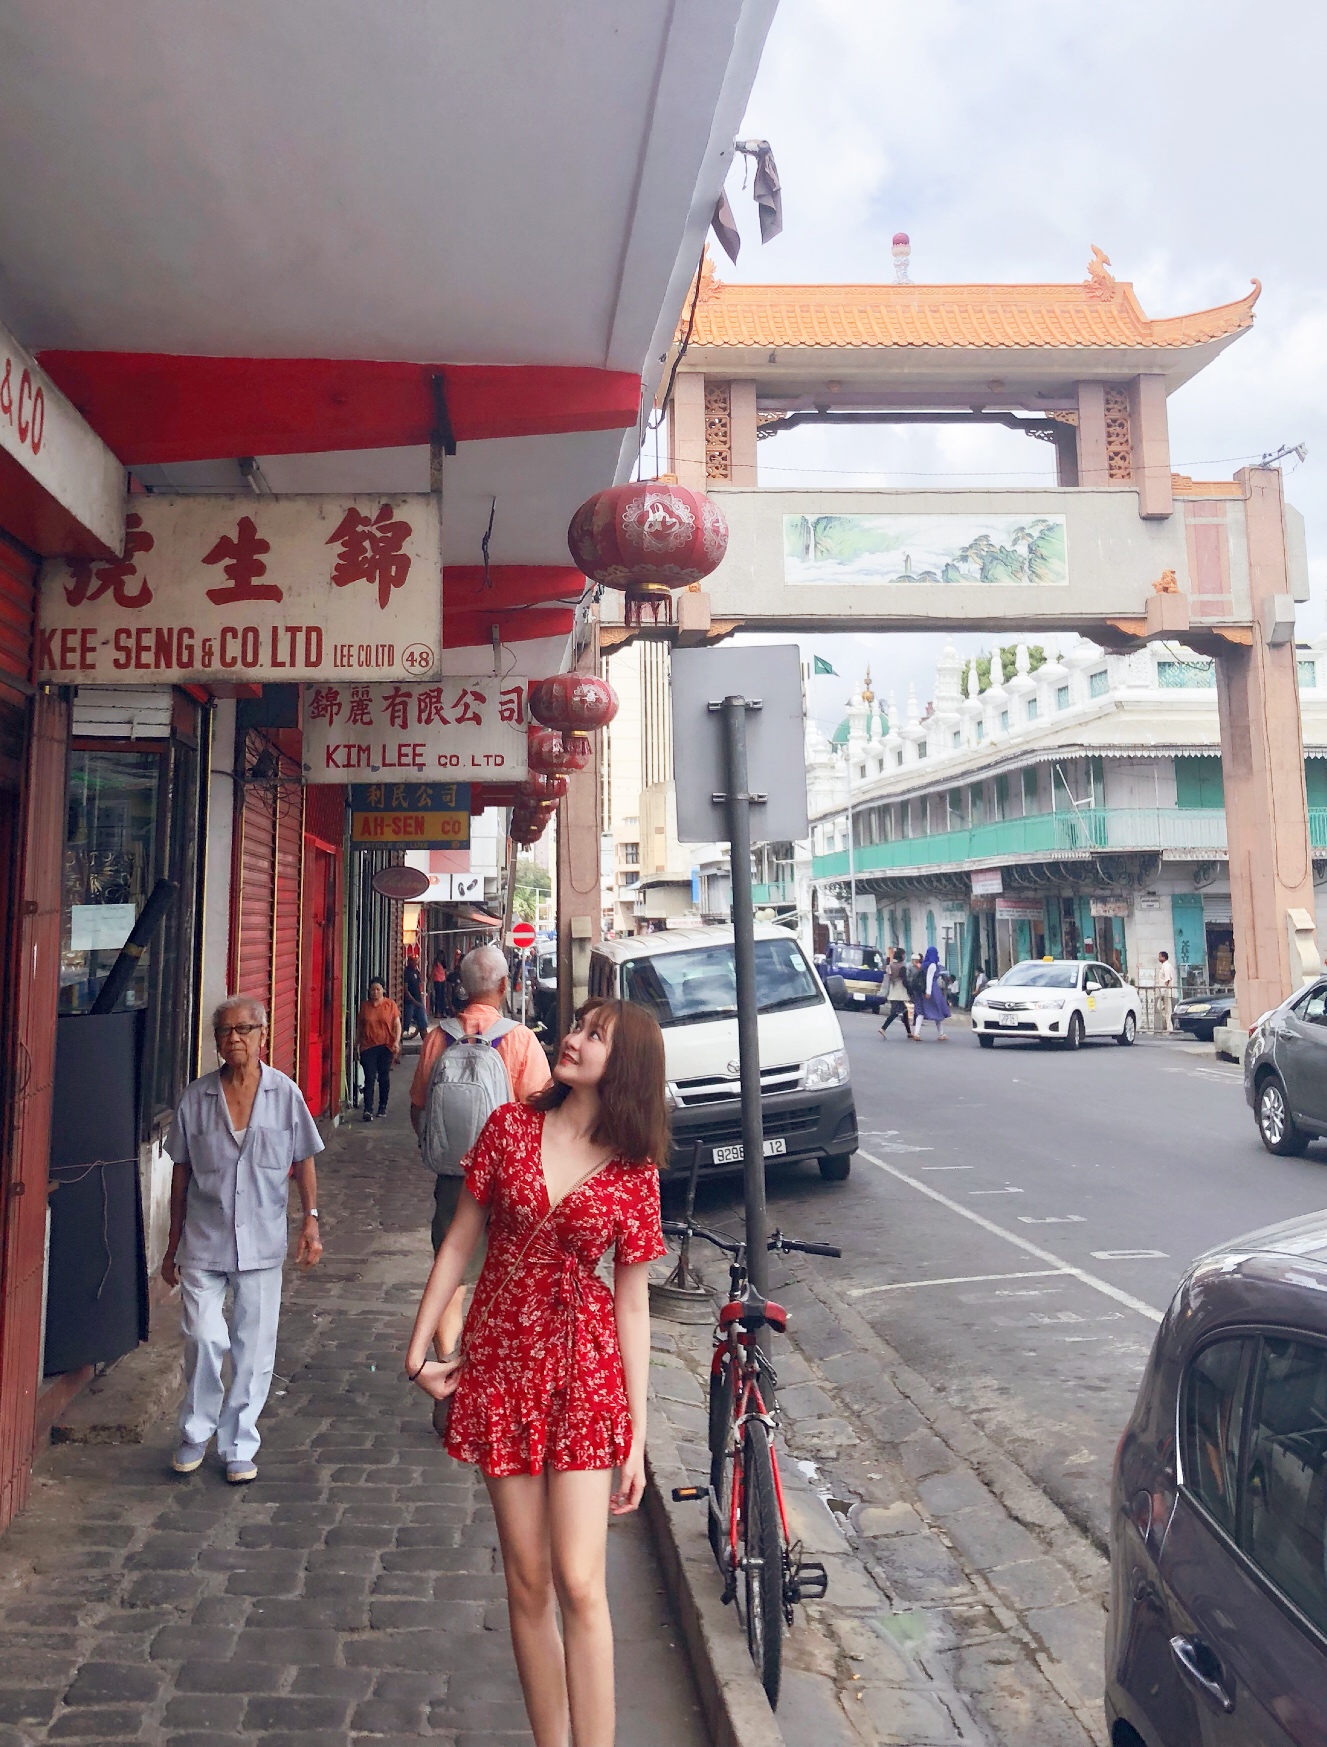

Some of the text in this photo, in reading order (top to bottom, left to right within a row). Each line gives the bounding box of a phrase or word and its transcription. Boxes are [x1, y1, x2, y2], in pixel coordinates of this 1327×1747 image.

[333, 644, 354, 668] LEE
[405, 651, 430, 668] 48
[307, 685, 525, 730] 錦麗有限公司
[325, 744, 371, 768] KIM
[381, 743, 427, 767] LEE
[471, 754, 505, 767] LTD
[360, 815, 462, 836] AH-SEN CO
[769, 1140, 784, 1154] 12
